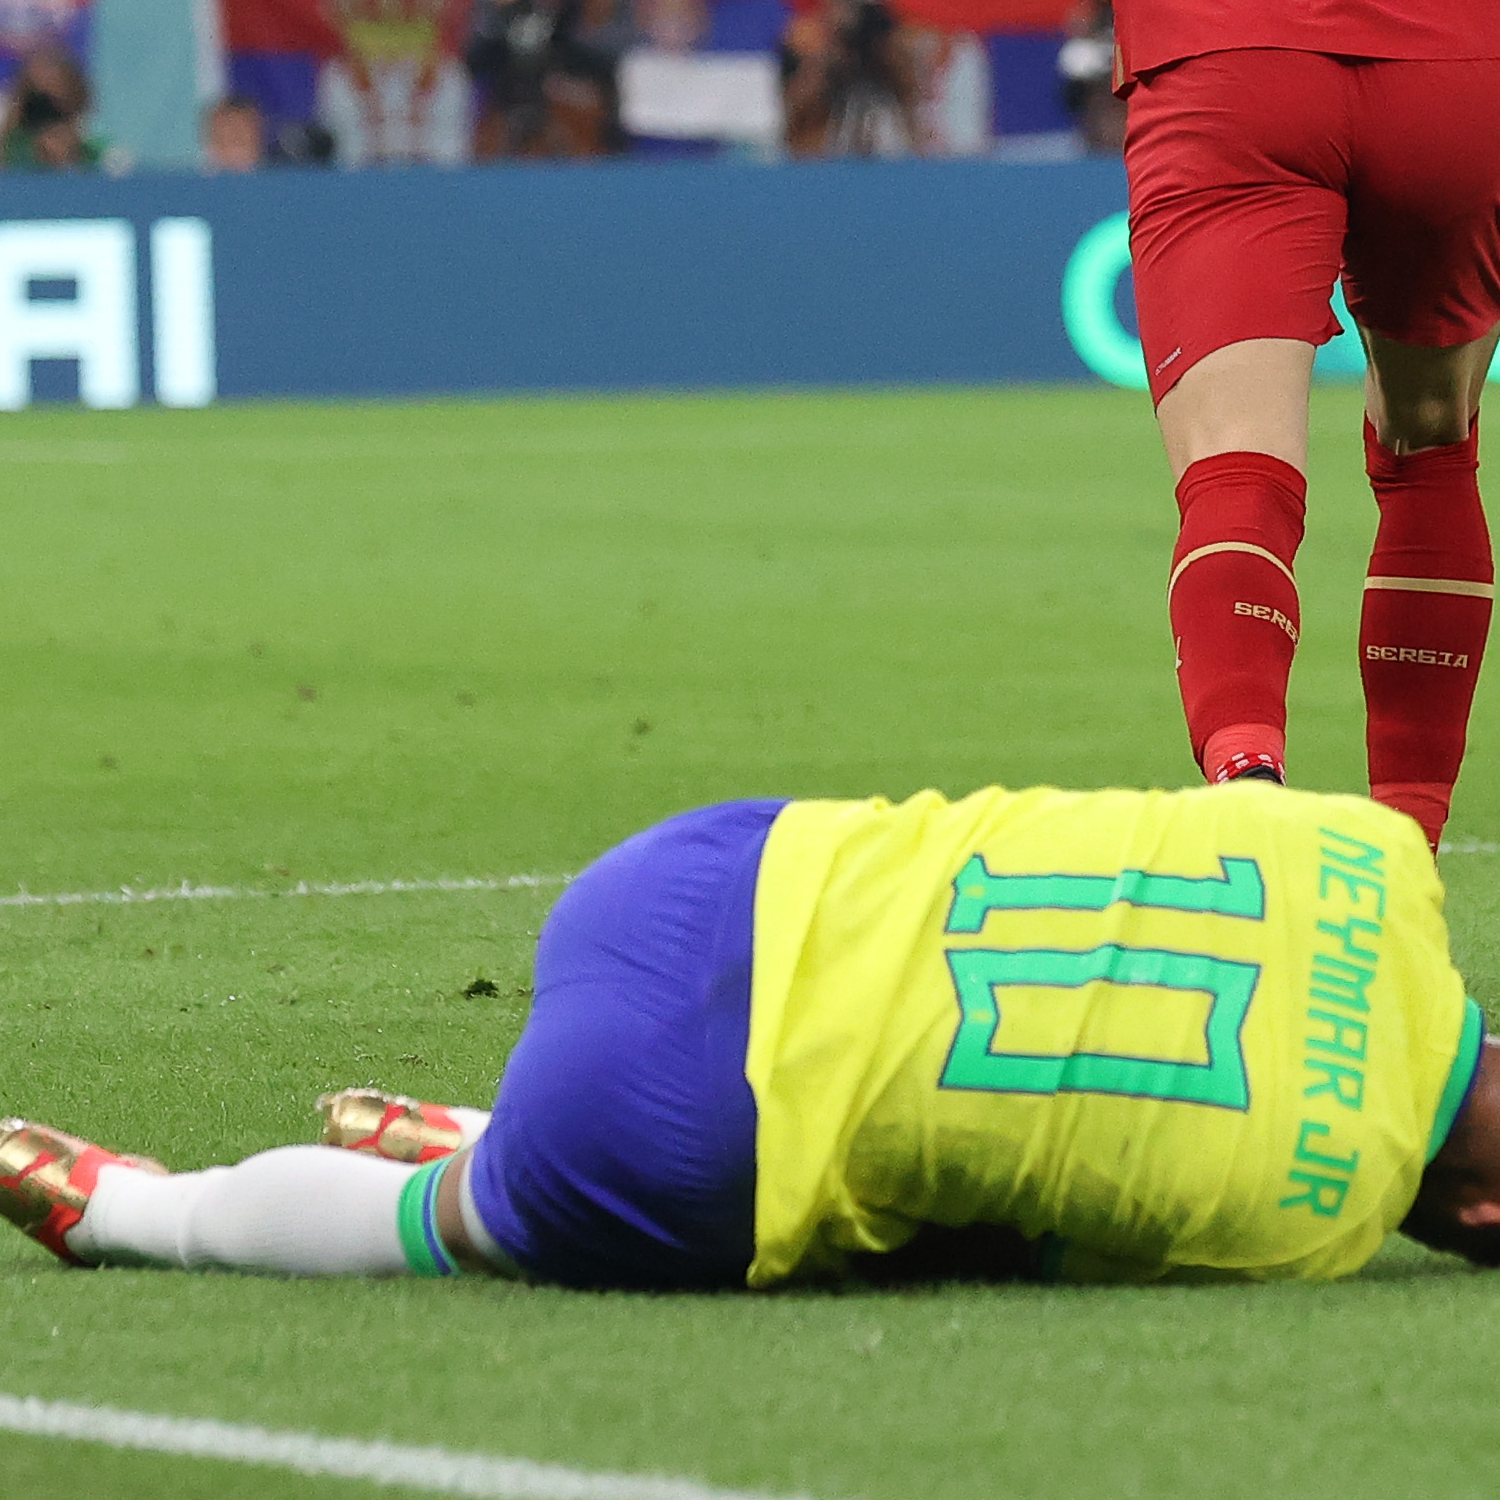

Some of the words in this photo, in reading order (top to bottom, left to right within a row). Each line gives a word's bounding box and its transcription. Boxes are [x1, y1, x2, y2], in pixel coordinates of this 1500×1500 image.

[937, 852, 1267, 1113] 10
[1303, 826, 1387, 1112] NEYMAR
[1279, 1120, 1360, 1220] JR
